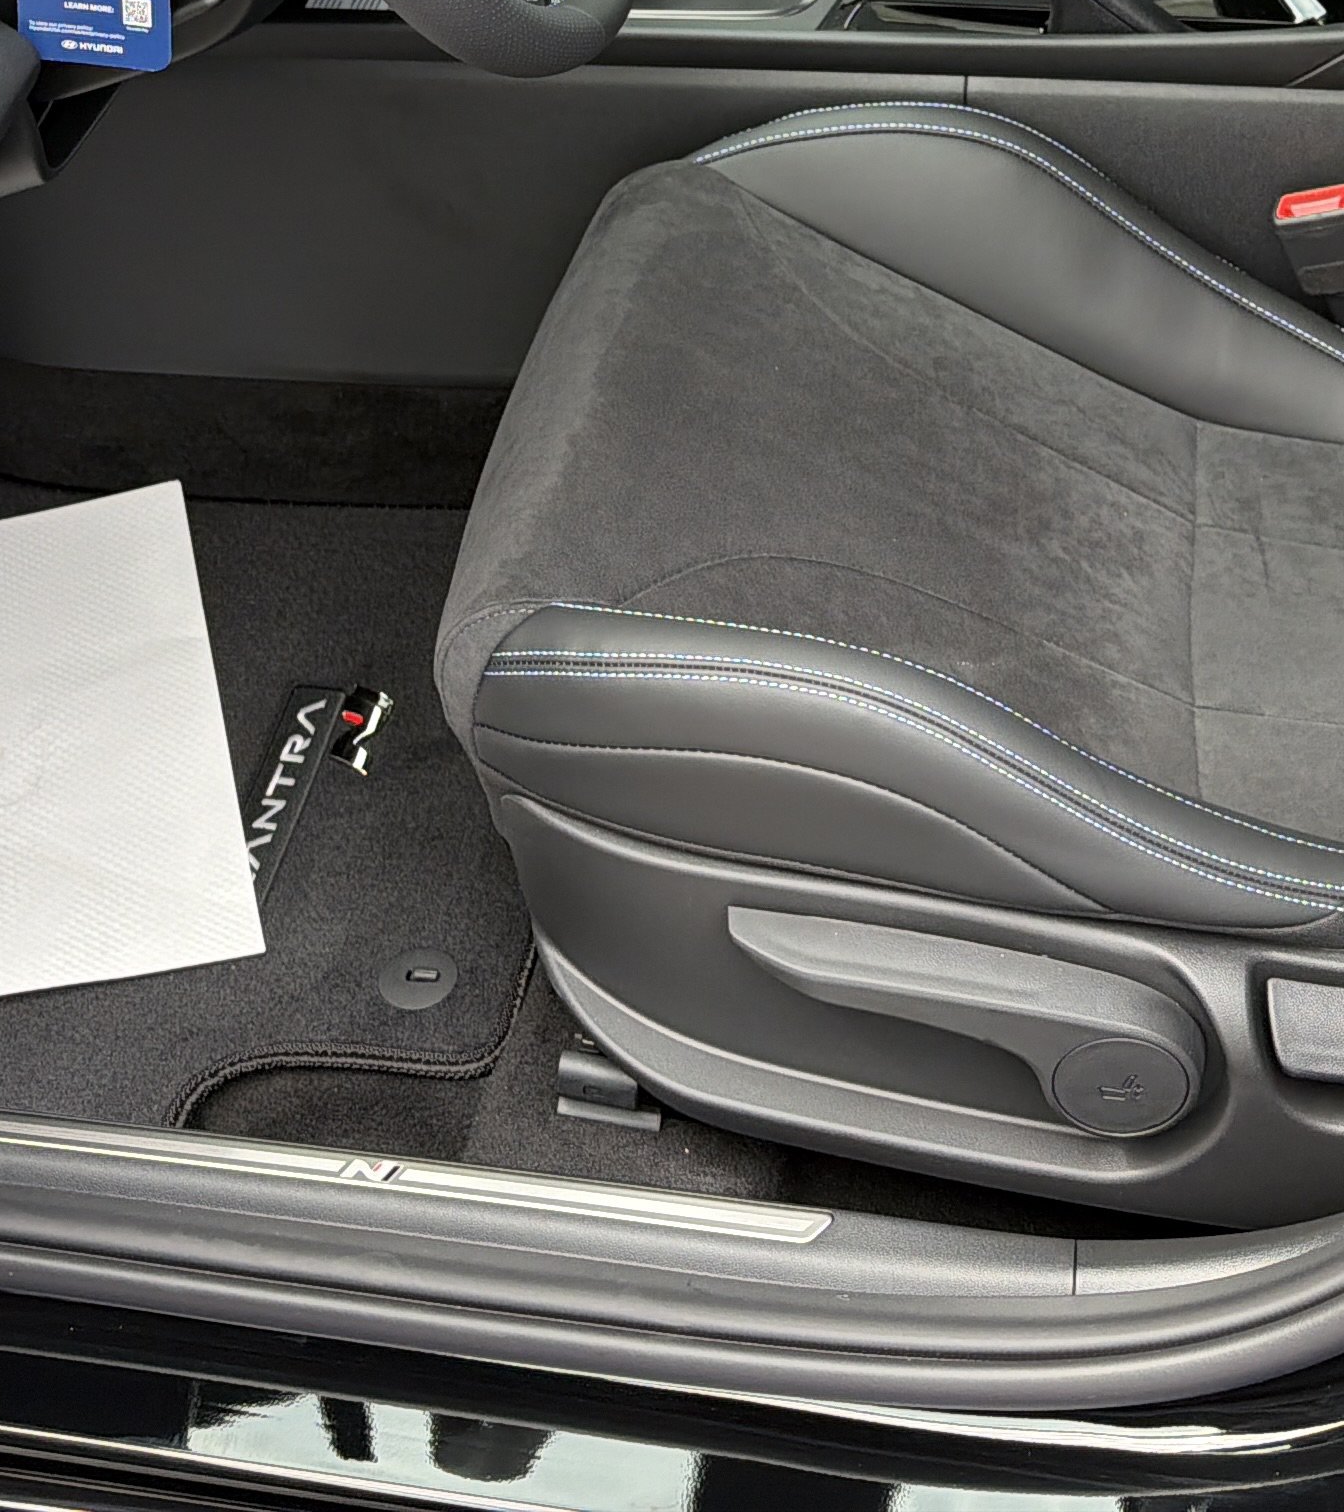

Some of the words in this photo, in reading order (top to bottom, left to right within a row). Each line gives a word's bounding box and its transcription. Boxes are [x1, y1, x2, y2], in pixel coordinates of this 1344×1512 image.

[64, 1, 89, 10] LEARN
[90, 4, 114, 13] MORE:
[79, 41, 124, 55] HYUNDAI
[247, 698, 327, 880] ANTRA
